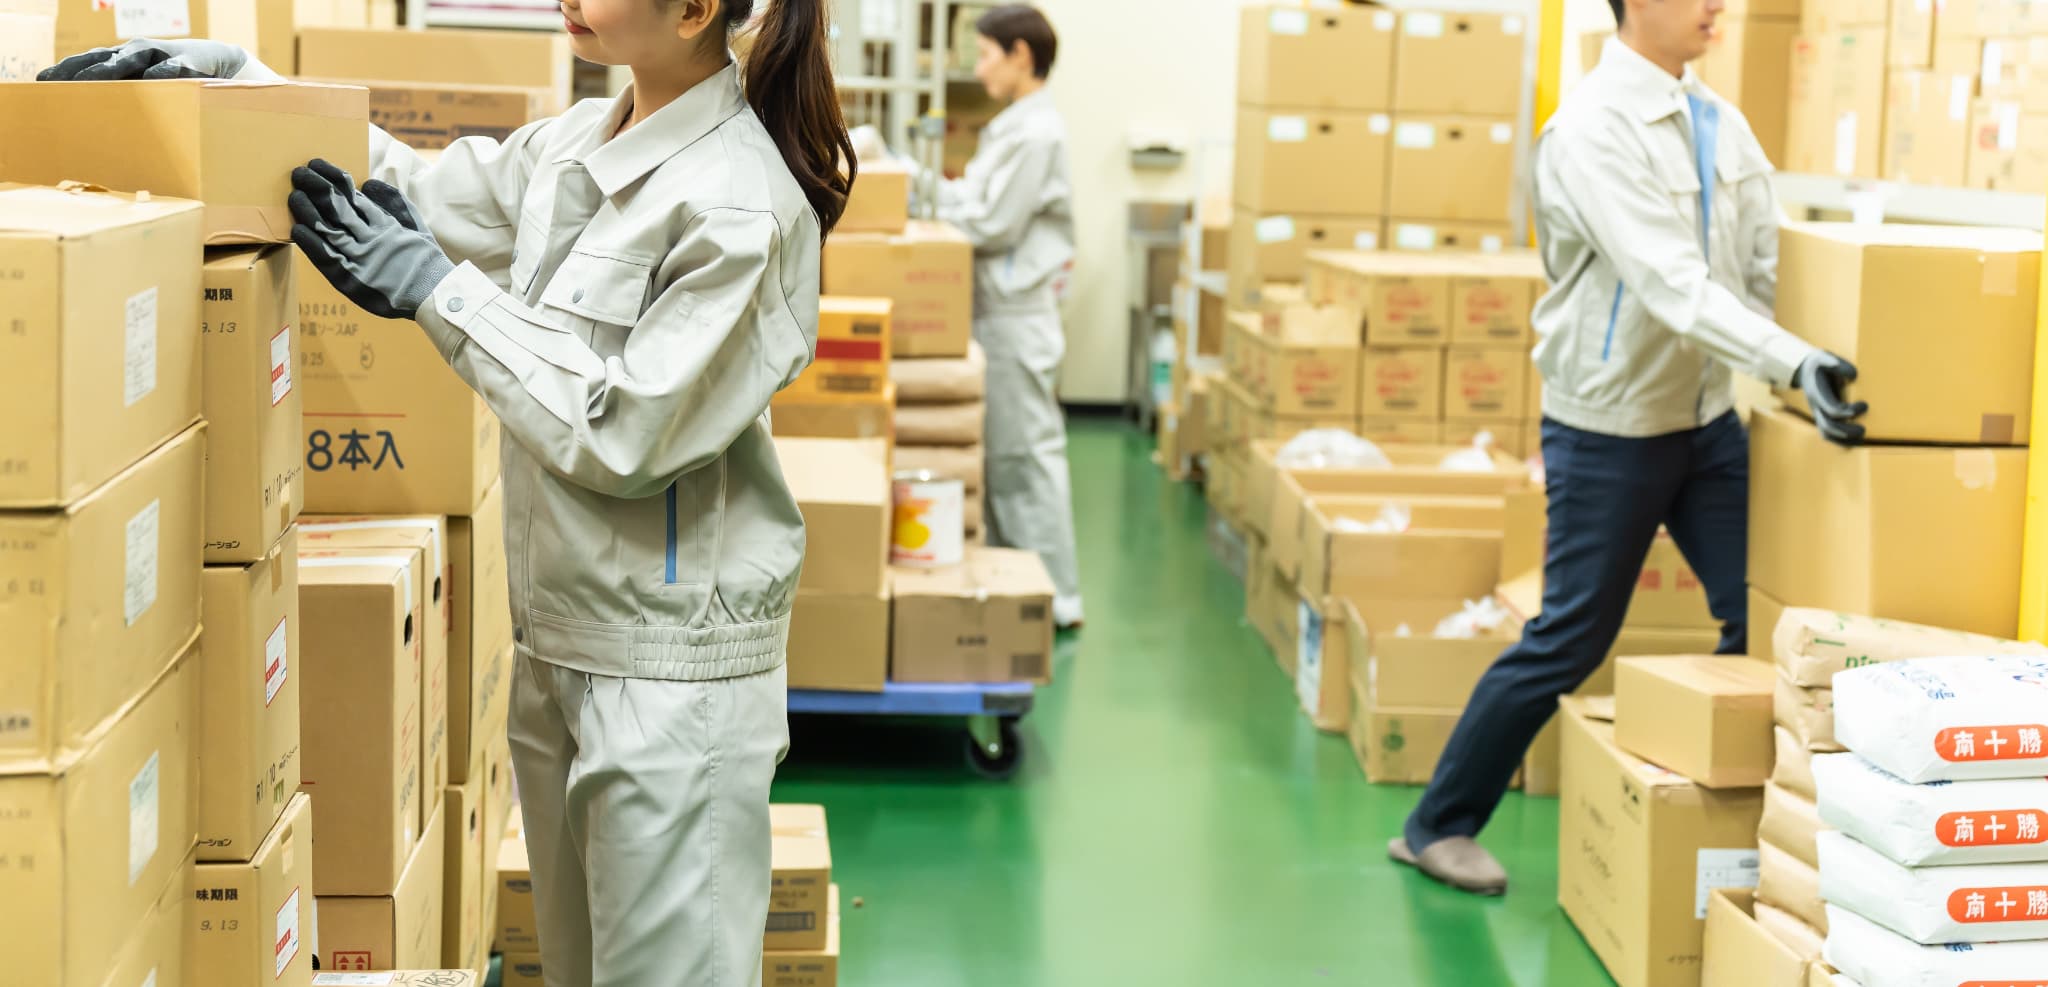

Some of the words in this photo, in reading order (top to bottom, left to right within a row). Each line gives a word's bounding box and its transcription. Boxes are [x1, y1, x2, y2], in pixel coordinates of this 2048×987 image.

[204, 287, 233, 302] 期限
[219, 321, 237, 333] 13
[306, 428, 404, 472] 8本入
[1953, 728, 2042, 757] 南十勝
[1954, 813, 2040, 842] 南十勝
[195, 888, 239, 901] 味期限
[1965, 890, 2048, 919] 南十勝
[220, 919, 239, 931] 13
